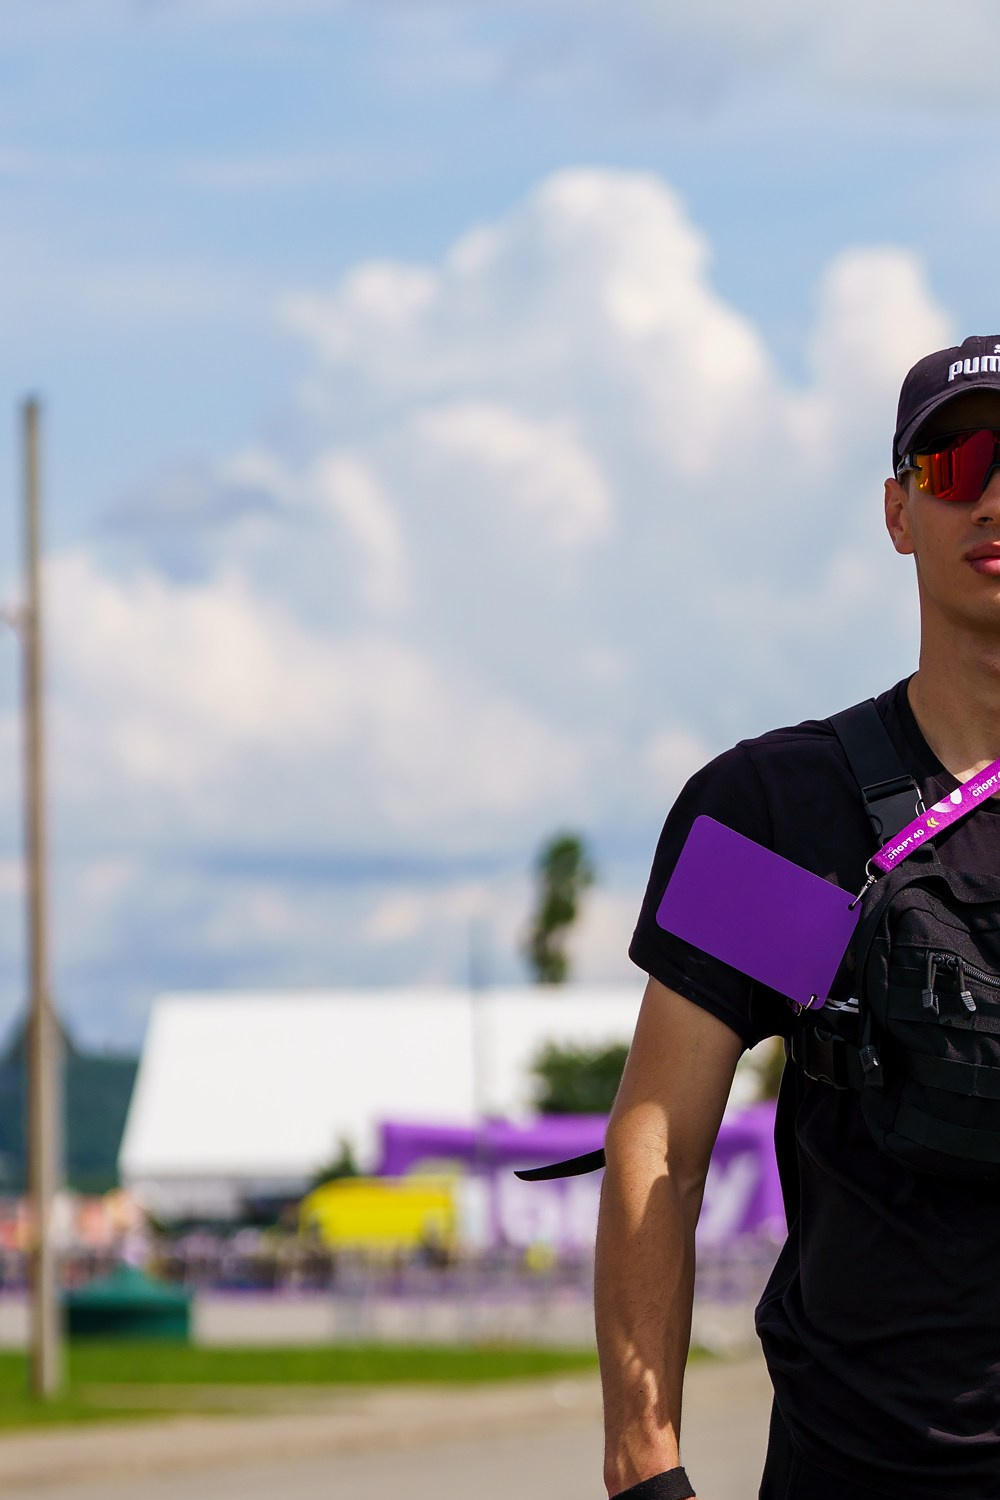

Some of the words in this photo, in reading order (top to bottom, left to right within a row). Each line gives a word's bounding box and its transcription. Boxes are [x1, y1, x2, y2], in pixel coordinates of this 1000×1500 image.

[972, 774, 998, 797] СПОРТ
[887, 836, 914, 860] СПОРТ
[913, 829, 925, 839] 40
